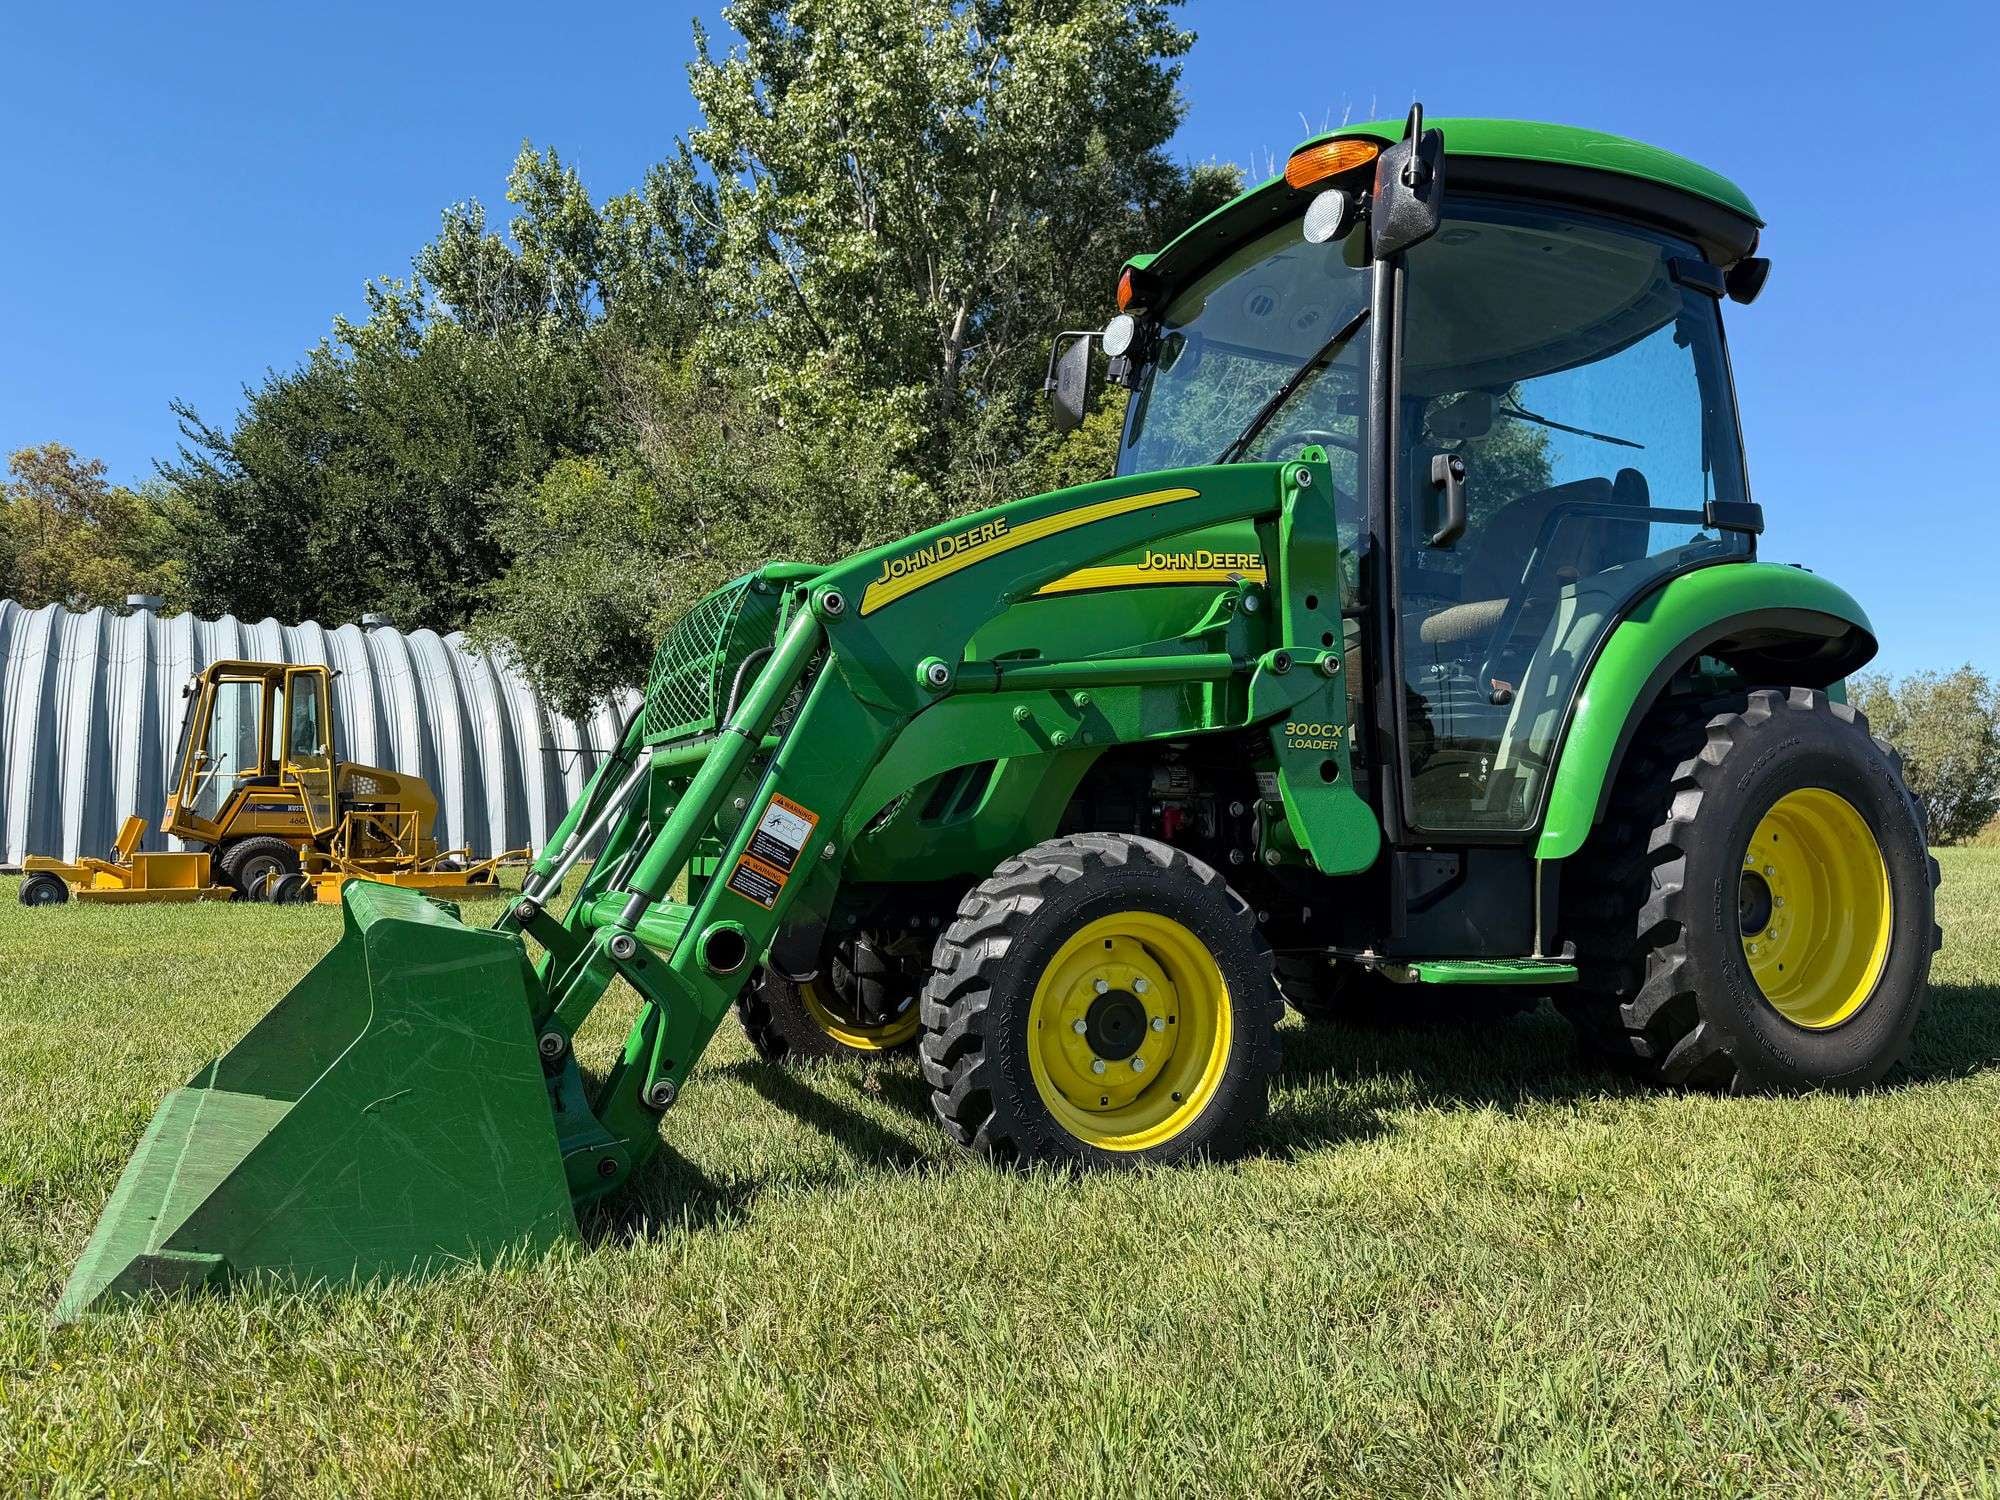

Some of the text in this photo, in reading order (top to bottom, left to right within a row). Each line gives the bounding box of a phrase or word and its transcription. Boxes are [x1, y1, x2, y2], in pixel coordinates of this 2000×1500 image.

[877, 516, 1009, 585] JOHN DEERE
[1138, 550, 1262, 569] JOHN DEERE
[1285, 722, 1344, 738] 300CX
[1287, 738, 1338, 750] LOADER
[784, 801, 813, 821] WARNING
[752, 863, 781, 882] WARNING
